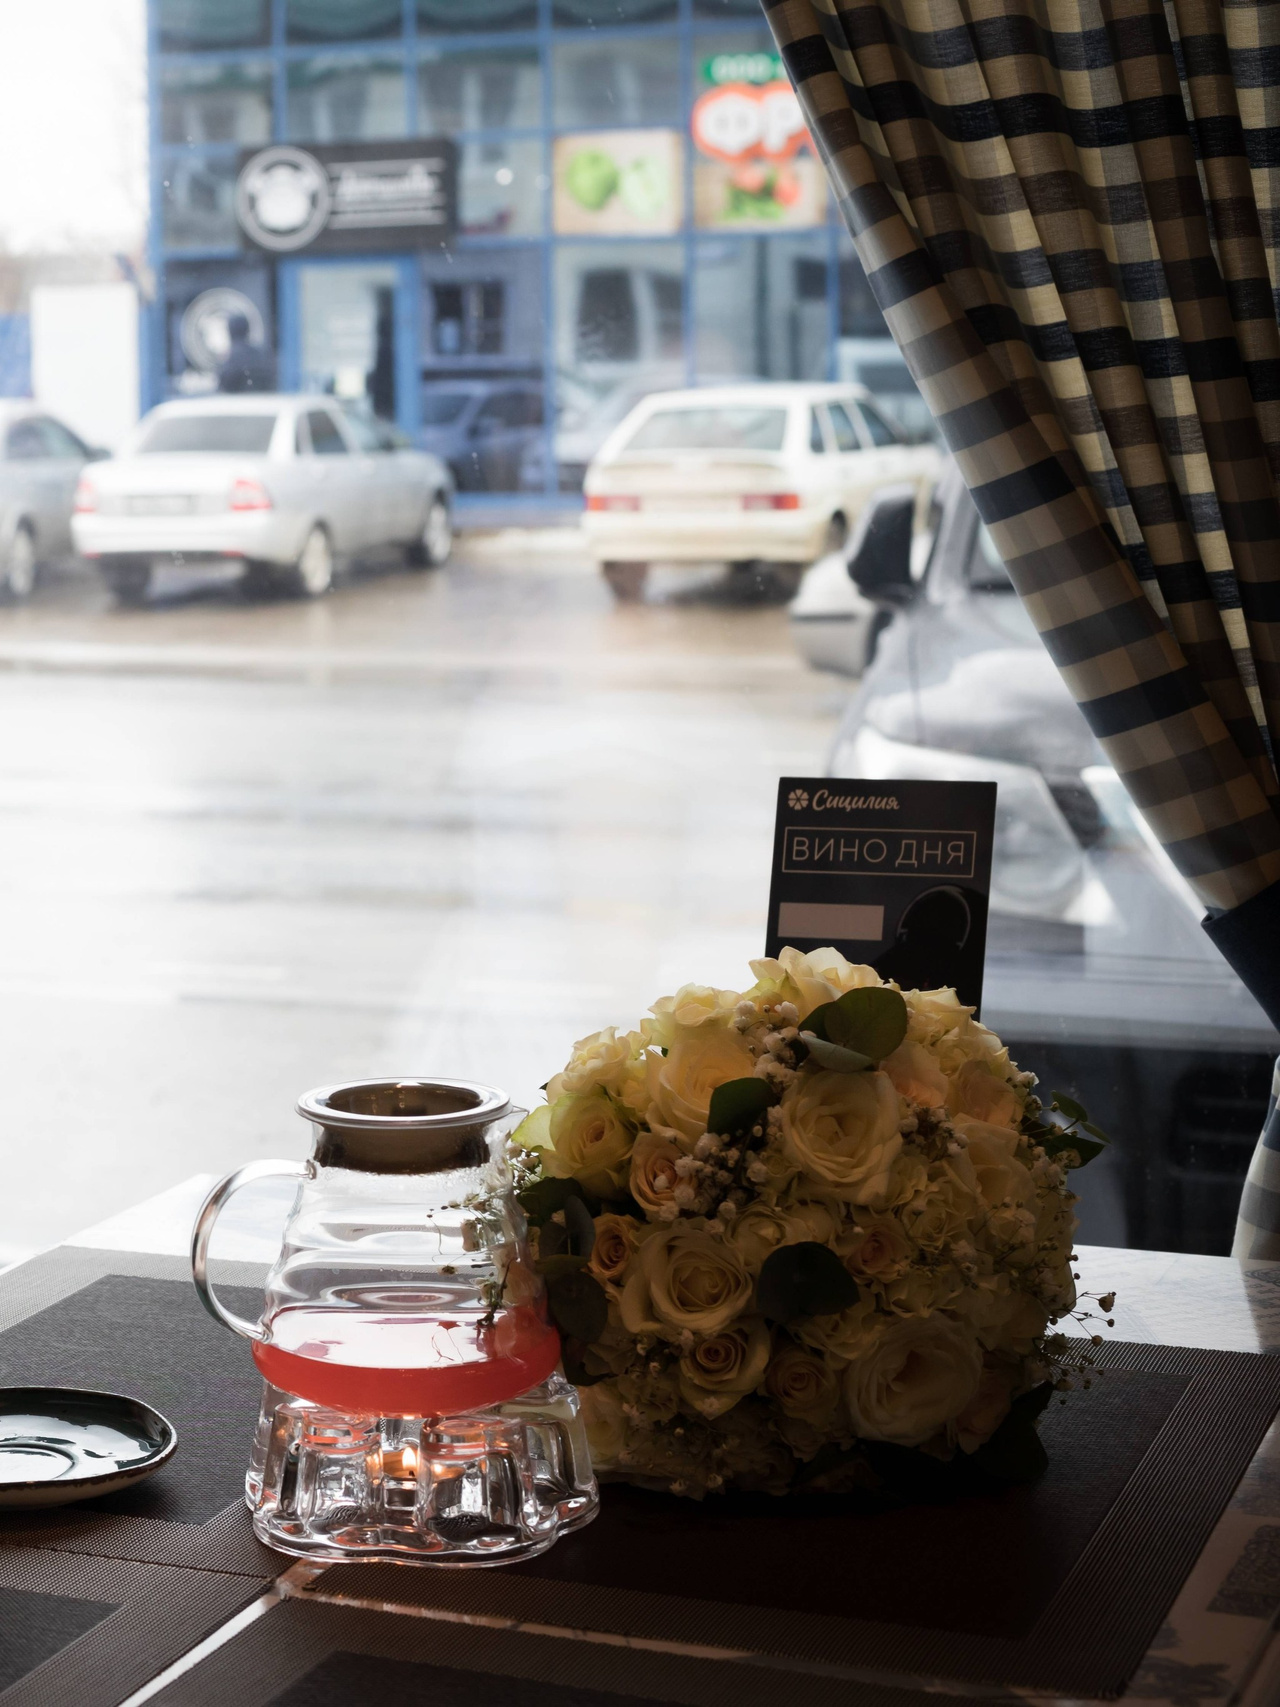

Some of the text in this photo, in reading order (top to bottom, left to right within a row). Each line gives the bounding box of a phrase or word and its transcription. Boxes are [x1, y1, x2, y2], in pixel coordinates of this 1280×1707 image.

[812, 789, 900, 812] Сицилия
[792, 837, 965, 868] ВИНО ДНЯ
